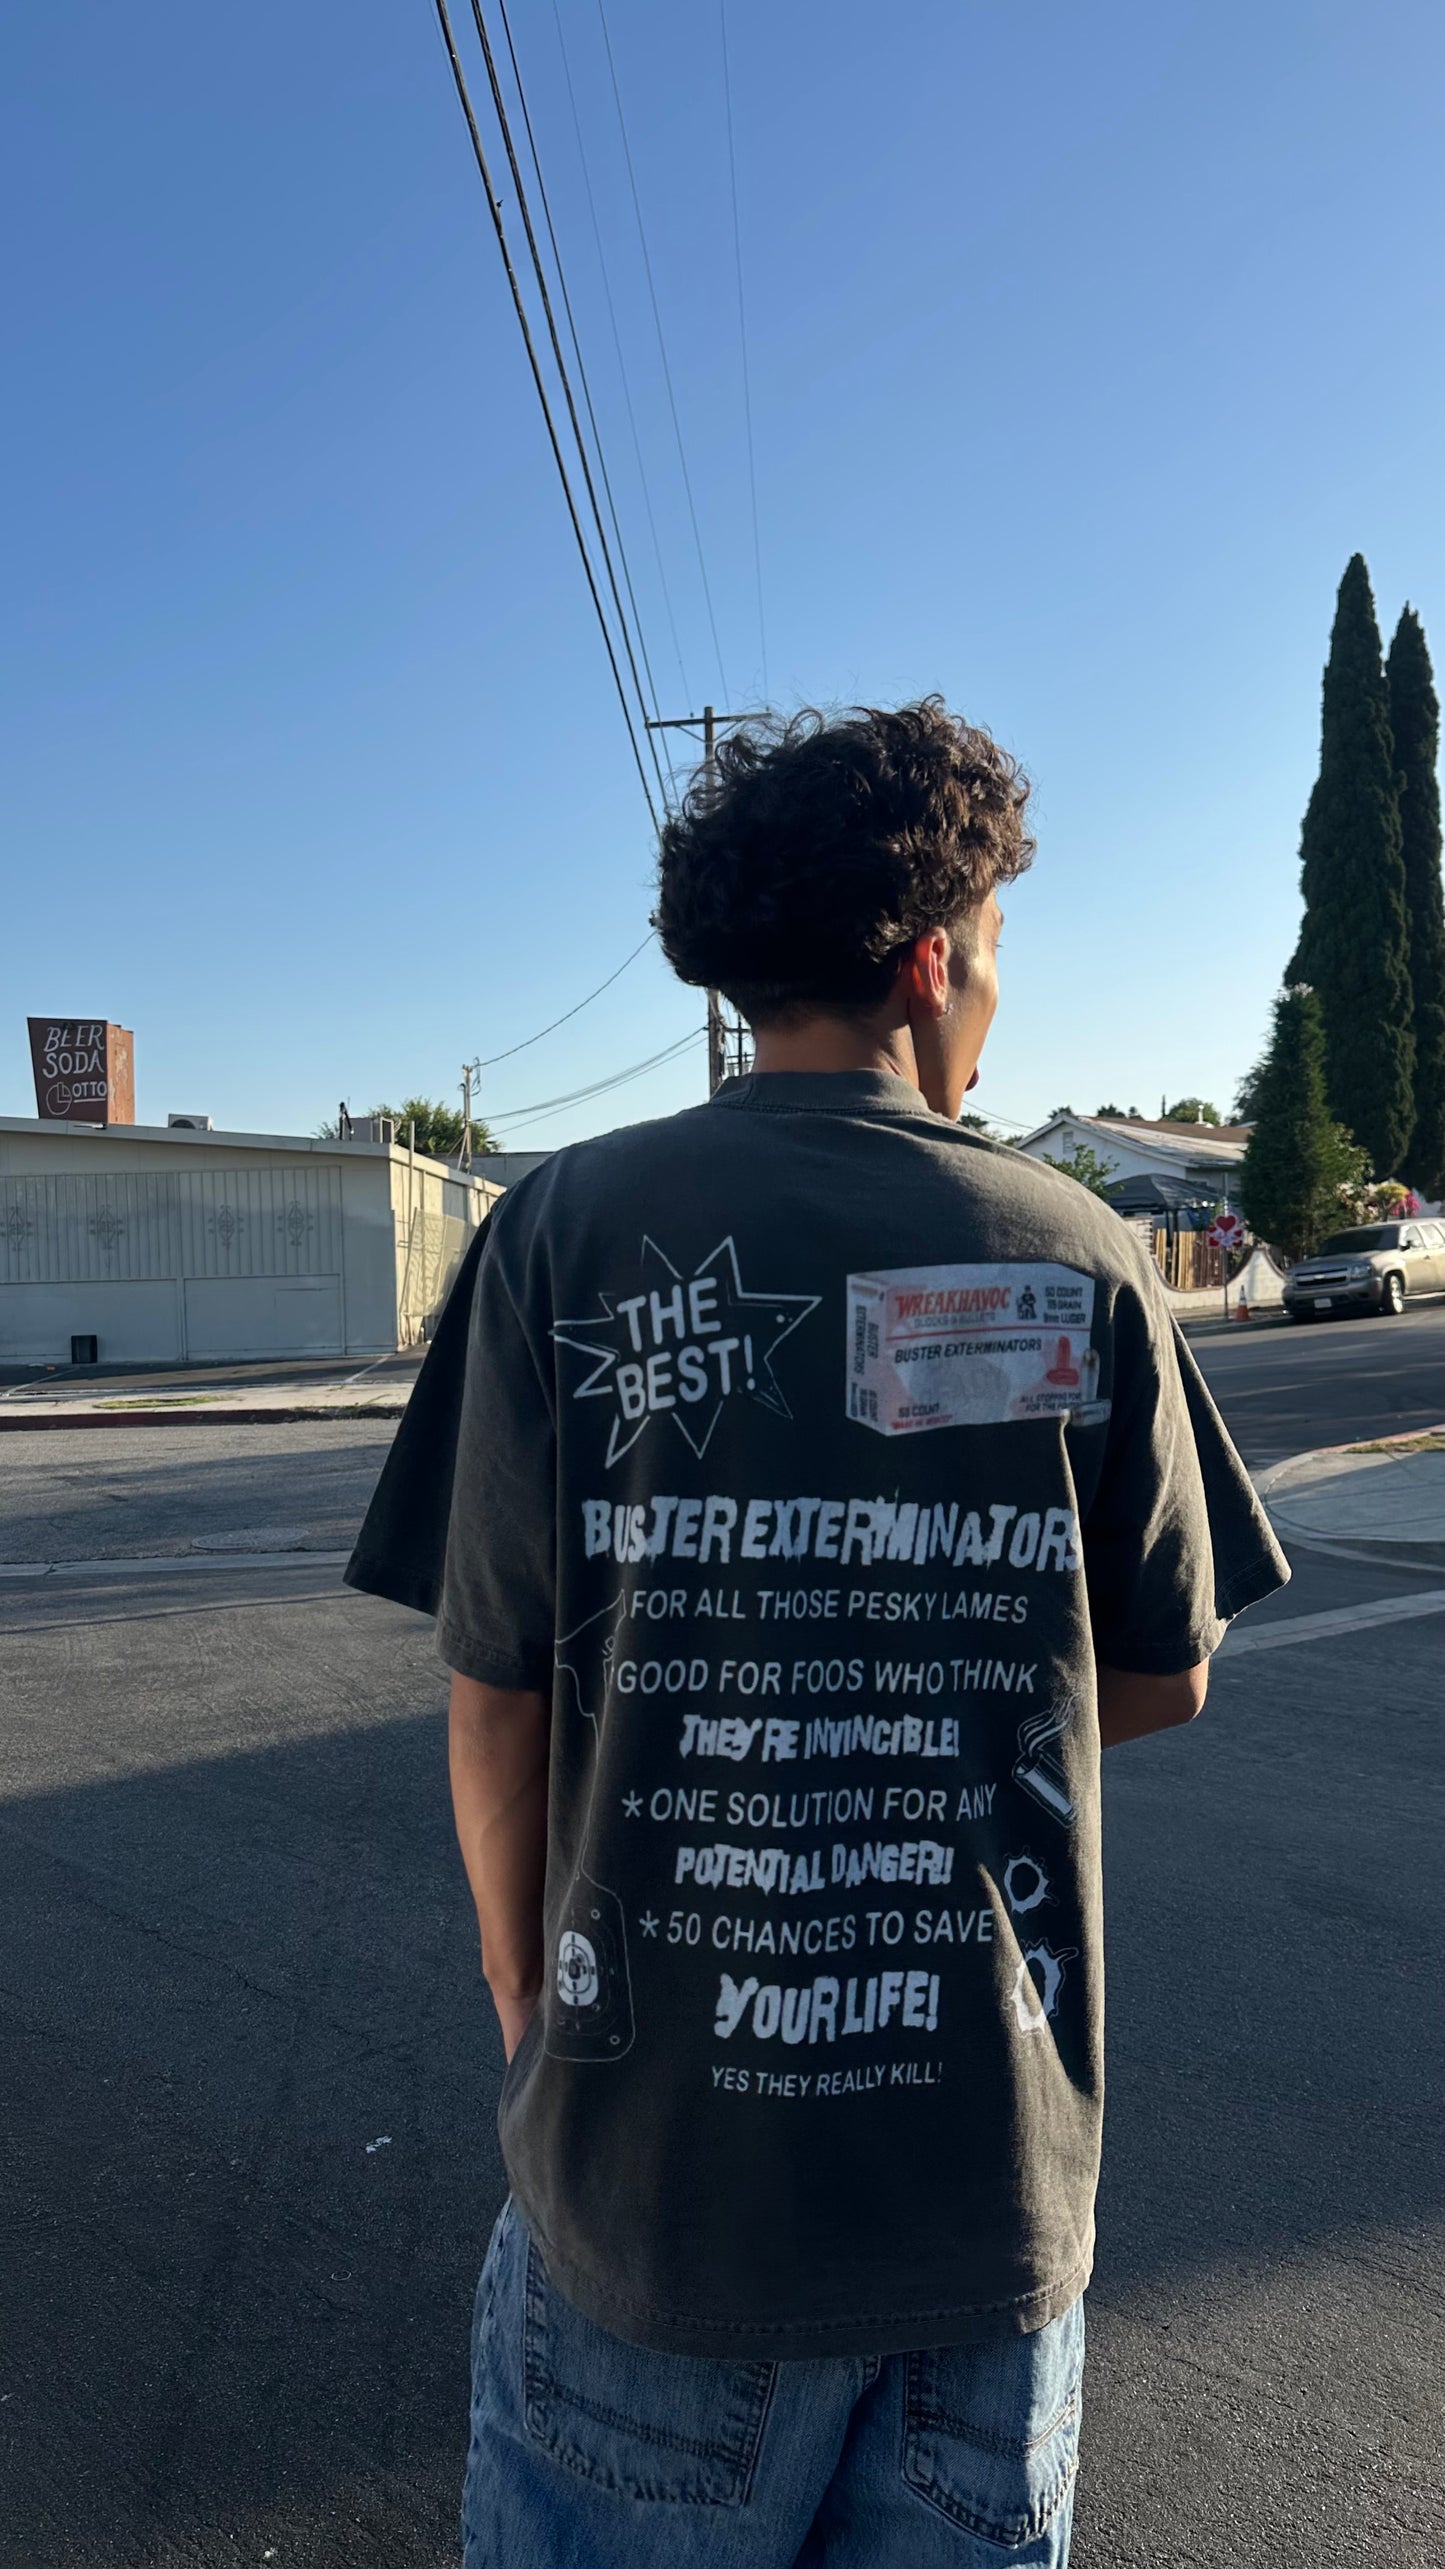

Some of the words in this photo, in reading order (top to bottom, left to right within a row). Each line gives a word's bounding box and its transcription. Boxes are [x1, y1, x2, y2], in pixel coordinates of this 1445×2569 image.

[43, 1024, 105, 1052] BEER
[42, 1049, 105, 1079] SODA
[617, 1277, 721, 1352] THE
[895, 1344, 942, 1363] BUSTER
[944, 1338, 1042, 1358] EXTERMINATORS
[616, 1335, 755, 1420] BEST!
[582, 1495, 737, 1563] BUSTER
[741, 1493, 1083, 1572] EXTERMINATORS
[630, 1590, 687, 1619] FOR
[695, 1589, 746, 1619] ALL
[757, 1589, 840, 1619] THOSE
[848, 1590, 937, 1621] PESKY
[942, 1591, 1028, 1623] LAMES
[617, 1659, 708, 1693] GOOD
[719, 1660, 781, 1694] FOR
[792, 1659, 864, 1694] FOOS
[875, 1661, 944, 1694] WHO
[950, 1659, 1037, 1693] THINK
[727, 1788, 874, 1827] SOLUTION
[883, 1788, 947, 1821] FOR
[956, 1783, 996, 1821] ANY
[675, 1844, 825, 1896] POTENTIAL
[712, 1915, 855, 1954] CHANCES
[866, 1911, 904, 1945] TO
[914, 1909, 994, 1945] SAVE
[714, 1973, 837, 2044] YOUR
[842, 1971, 940, 2035] LIFE!
[712, 2066, 749, 2092] YES
[756, 2072, 811, 2097] THEY
[816, 2065, 885, 2096] REALLY
[890, 2062, 942, 2085] KILL!
